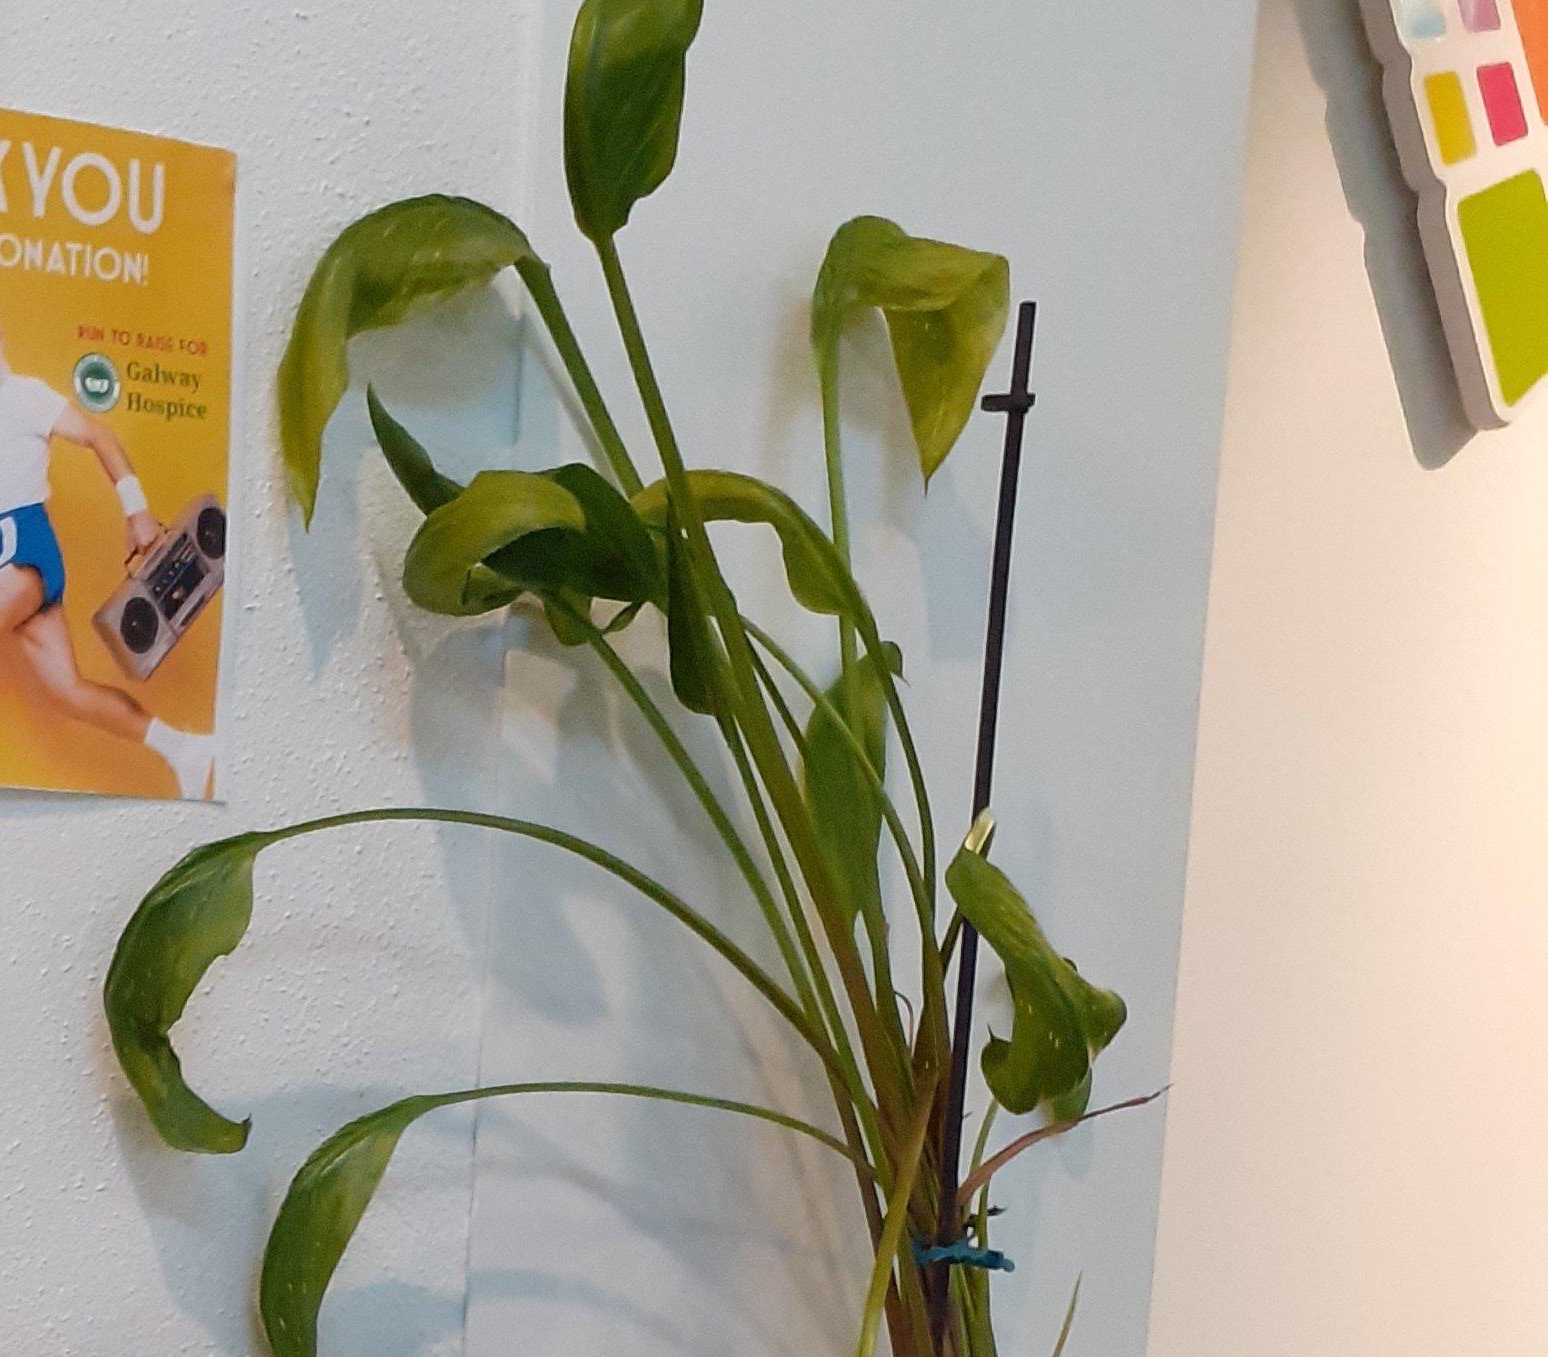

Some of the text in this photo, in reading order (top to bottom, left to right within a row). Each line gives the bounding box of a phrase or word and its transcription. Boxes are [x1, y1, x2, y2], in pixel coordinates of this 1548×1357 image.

[22, 140, 165, 234] YOU
[77, 324, 209, 356] RUN TO RAISE FOR
[127, 361, 202, 394] Galway
[127, 391, 207, 421] Hospice
